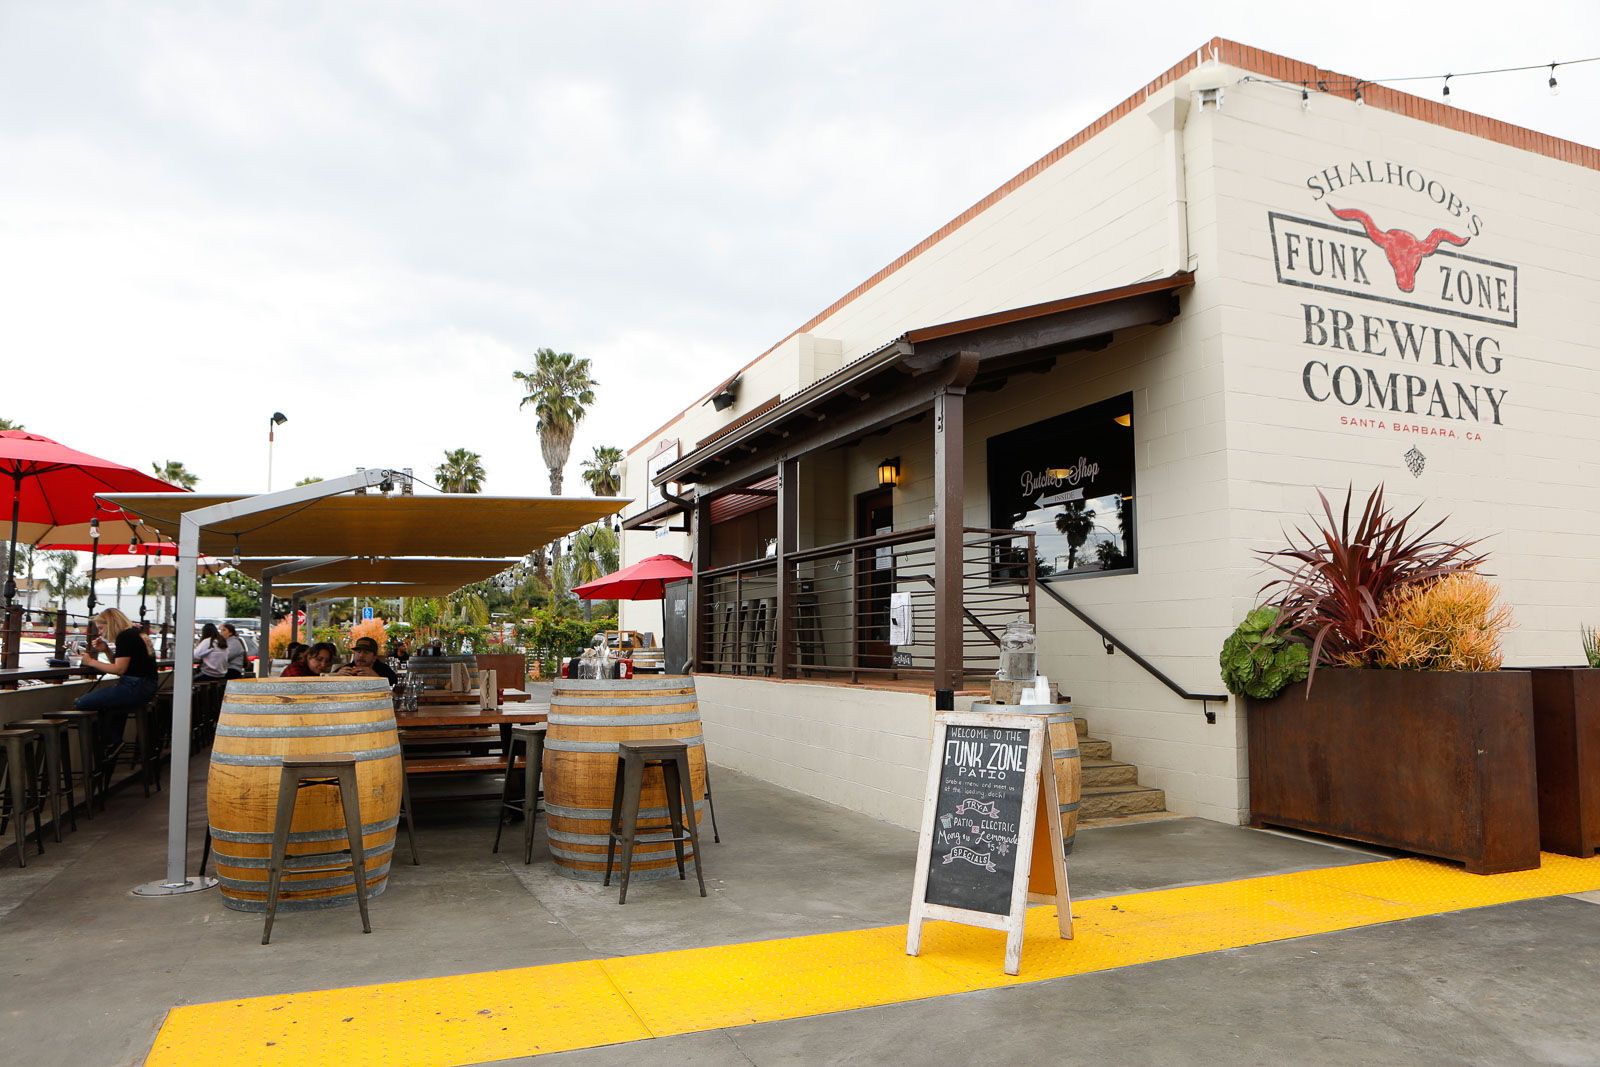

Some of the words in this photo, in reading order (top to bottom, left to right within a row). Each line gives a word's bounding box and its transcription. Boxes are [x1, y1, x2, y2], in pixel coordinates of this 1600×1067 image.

[1307, 160, 1483, 237] SHALHOOB'S
[1284, 231, 1371, 286] FUNK
[1439, 265, 1511, 314] ZONE
[1300, 303, 1503, 375] BREWING
[1302, 360, 1508, 426] COMPANY
[1340, 416, 1386, 430] SANTA
[1393, 422, 1460, 440] BARBARA,
[1466, 431, 1482, 441] CA
[1021, 467, 1063, 497] Butcher
[1067, 456, 1100, 486] Shop
[1054, 491, 1075, 502] INSIDE
[951, 727, 988, 739] WELCOME
[993, 729, 1002, 740] TO
[1006, 730, 1022, 741] THE
[945, 740, 983, 768] FUNK
[986, 743, 1027, 772] ZONE
[958, 766, 1006, 780] PATIO
[953, 816, 974, 828] PATIO
[981, 819, 1015, 833] ELECTRIC
[953, 848, 988, 864] SPECIALS
